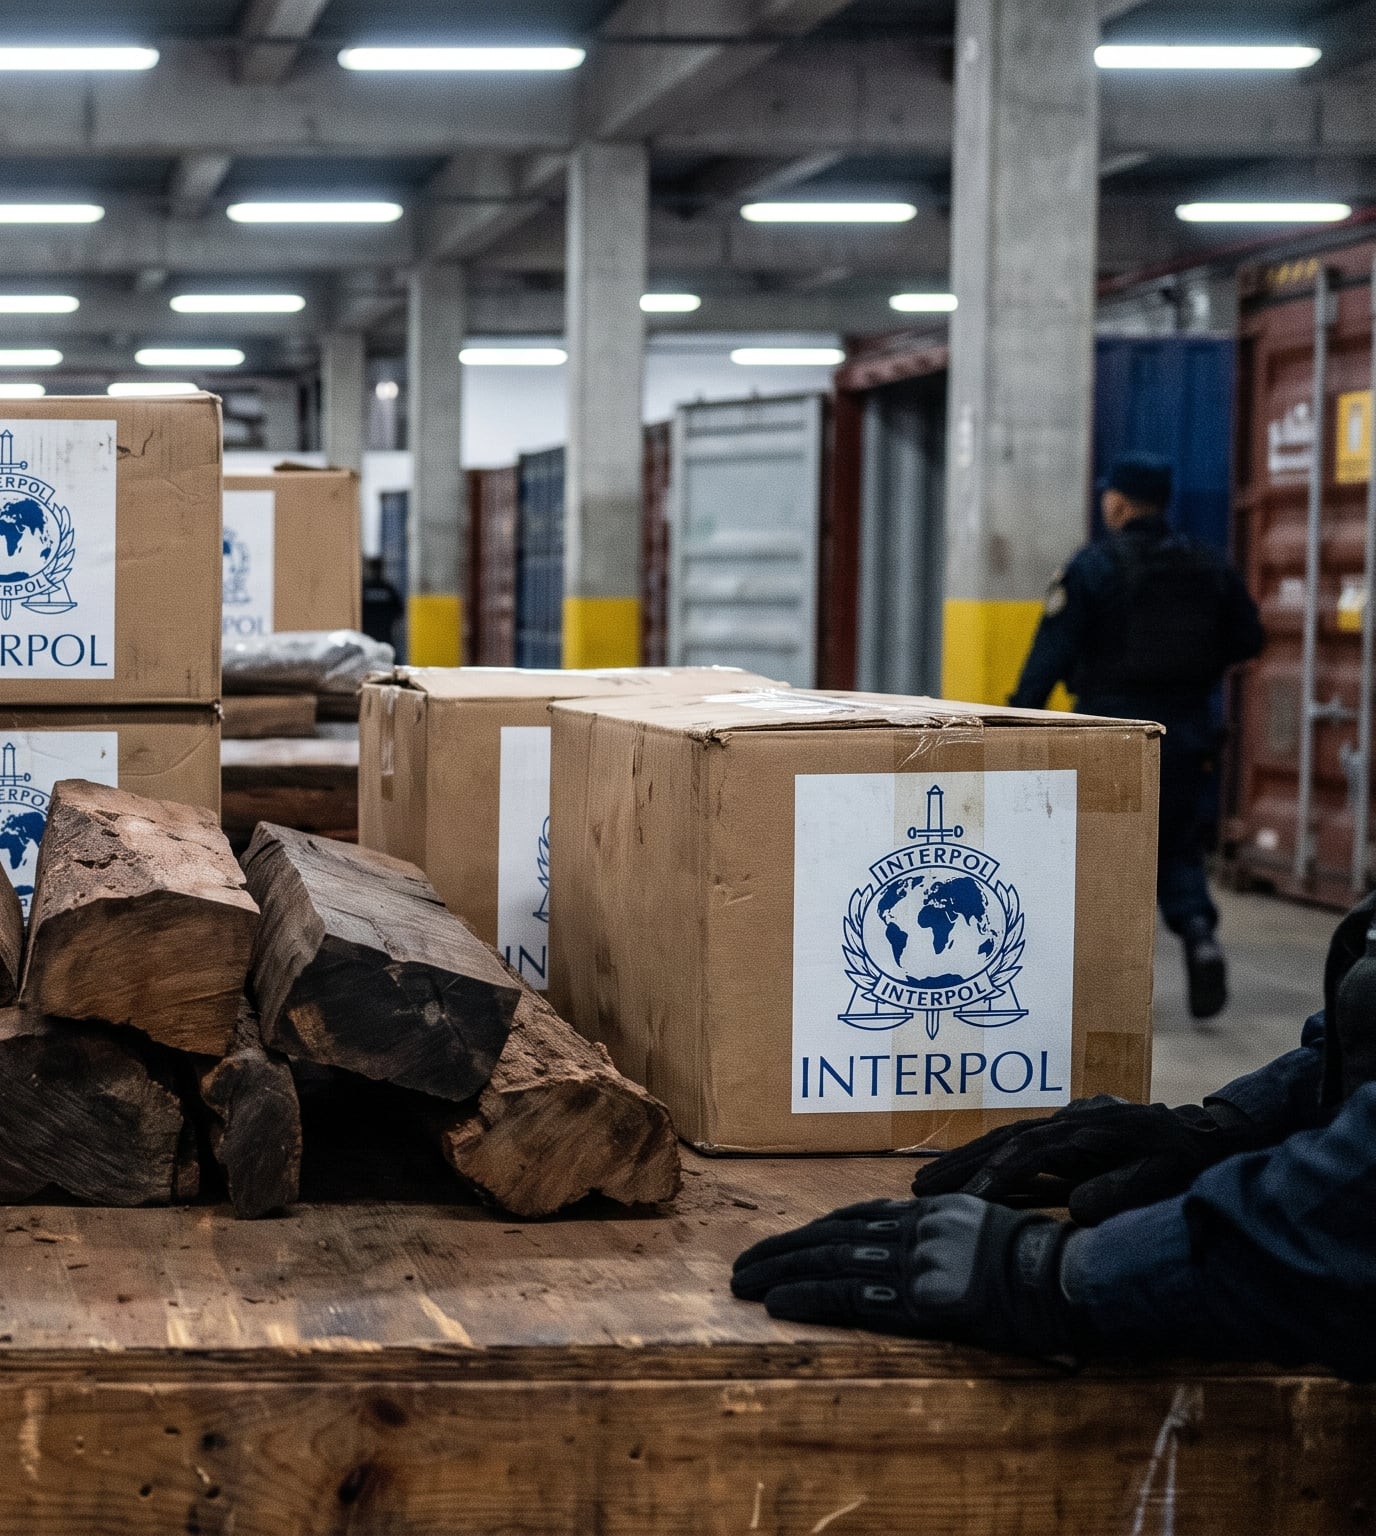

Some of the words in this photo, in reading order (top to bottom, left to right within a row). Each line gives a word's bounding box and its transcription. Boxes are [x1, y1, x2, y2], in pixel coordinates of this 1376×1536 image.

[878, 847, 991, 879] INTERPOL
[880, 981, 987, 1007] INTERPOL
[801, 1050, 1062, 1099] INTERPOL
